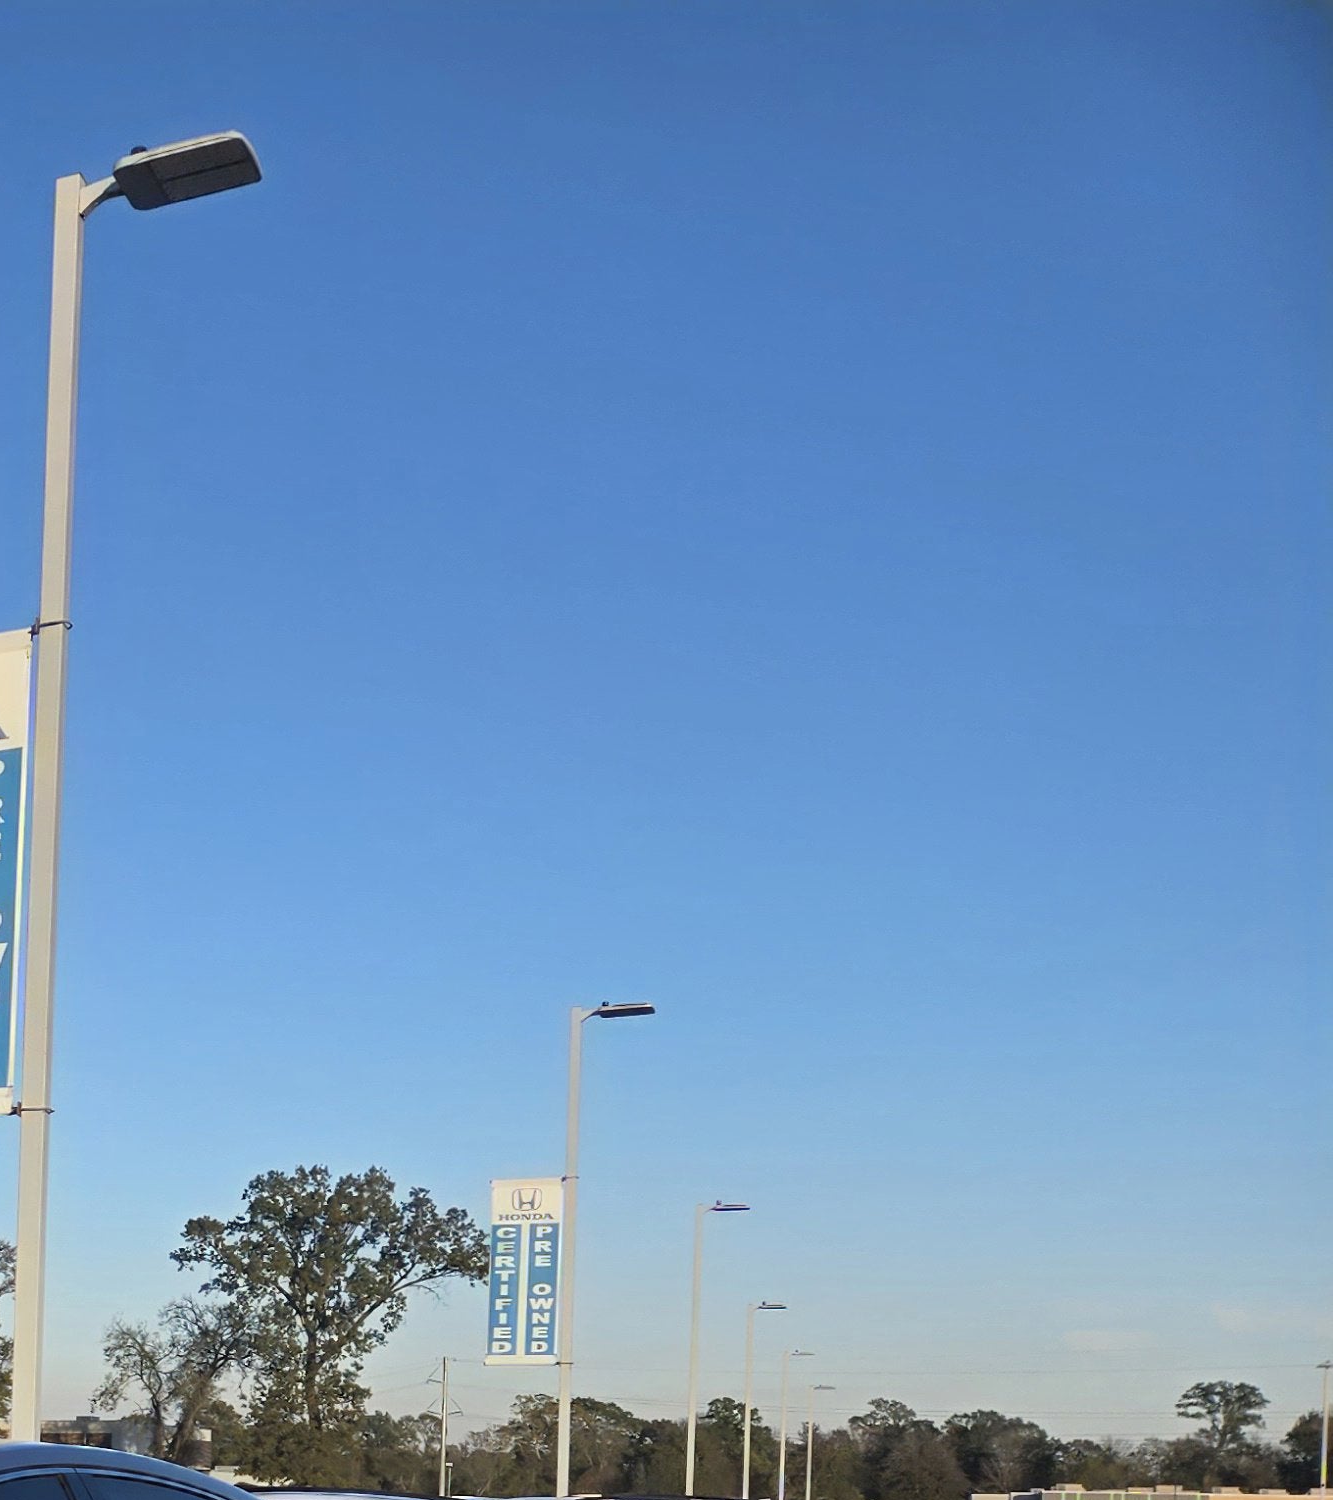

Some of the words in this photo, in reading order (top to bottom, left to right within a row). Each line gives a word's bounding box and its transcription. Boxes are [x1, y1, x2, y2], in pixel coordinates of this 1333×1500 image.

[497, 1212, 554, 1221] HONDA
[534, 1226, 553, 1267] PRE
[491, 1226, 517, 1354] CERTIFIED
[529, 1283, 554, 1353] OWNED
